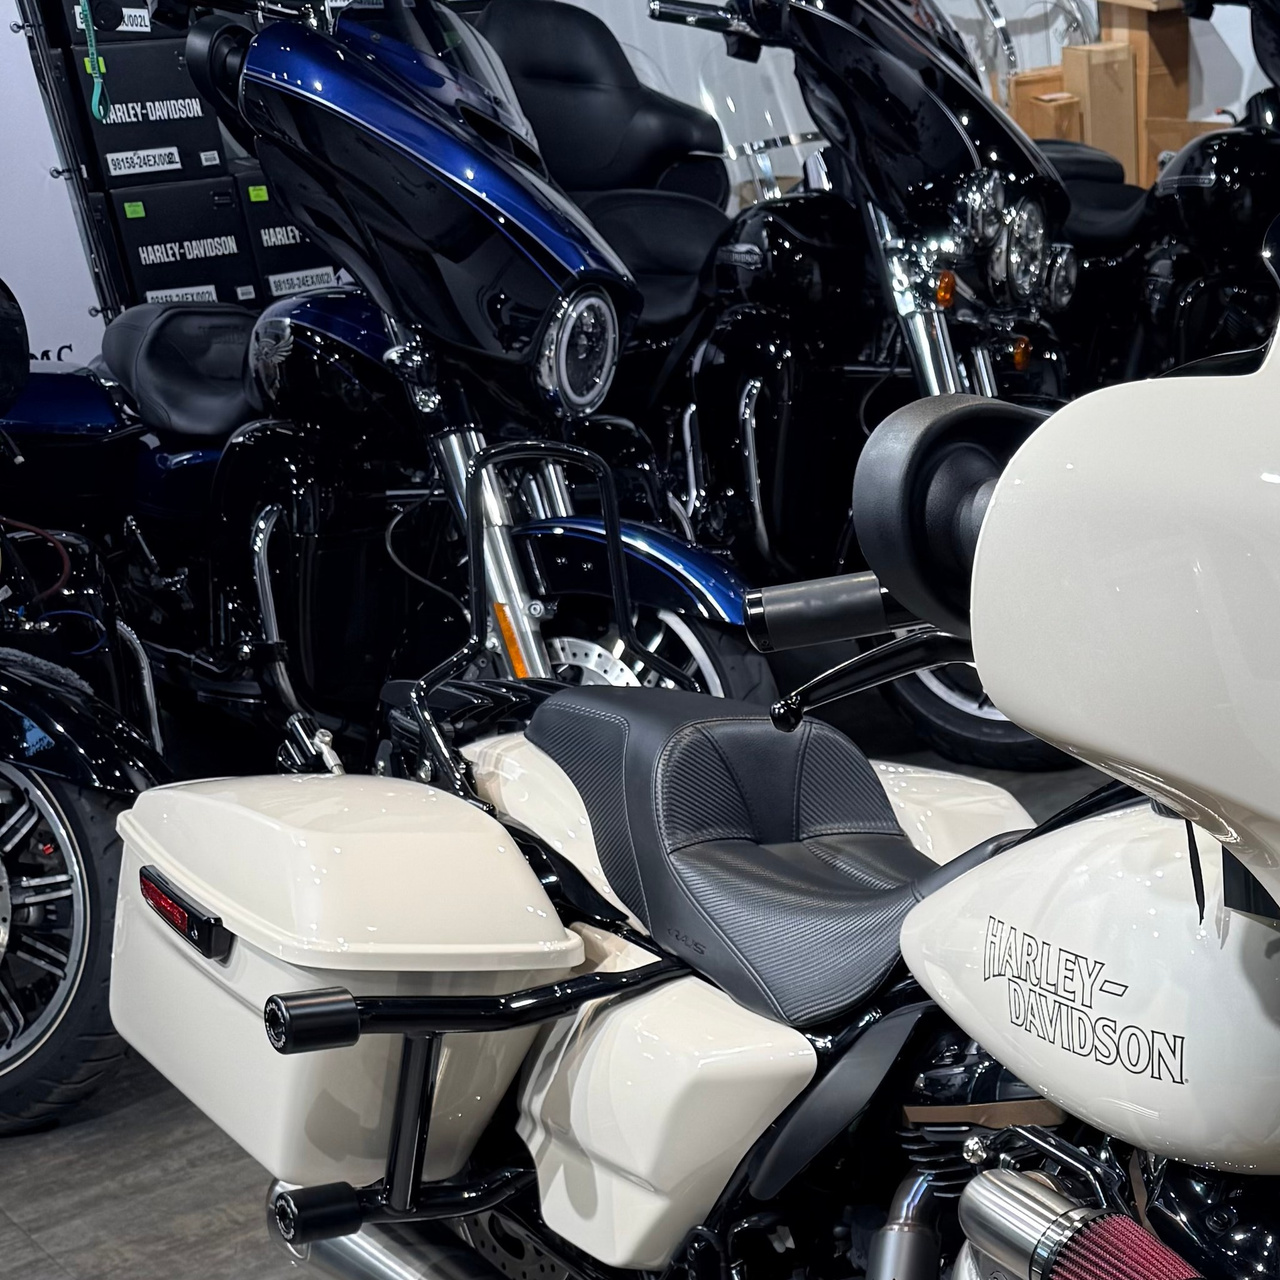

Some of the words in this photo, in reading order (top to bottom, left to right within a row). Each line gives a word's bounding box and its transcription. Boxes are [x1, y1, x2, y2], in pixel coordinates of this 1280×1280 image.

[139, 235, 237, 265] HARLEY-DAVIDSON
[984, 915, 1129, 1009] HARLEY-
[1007, 977, 1186, 1085] DAVIDSON
